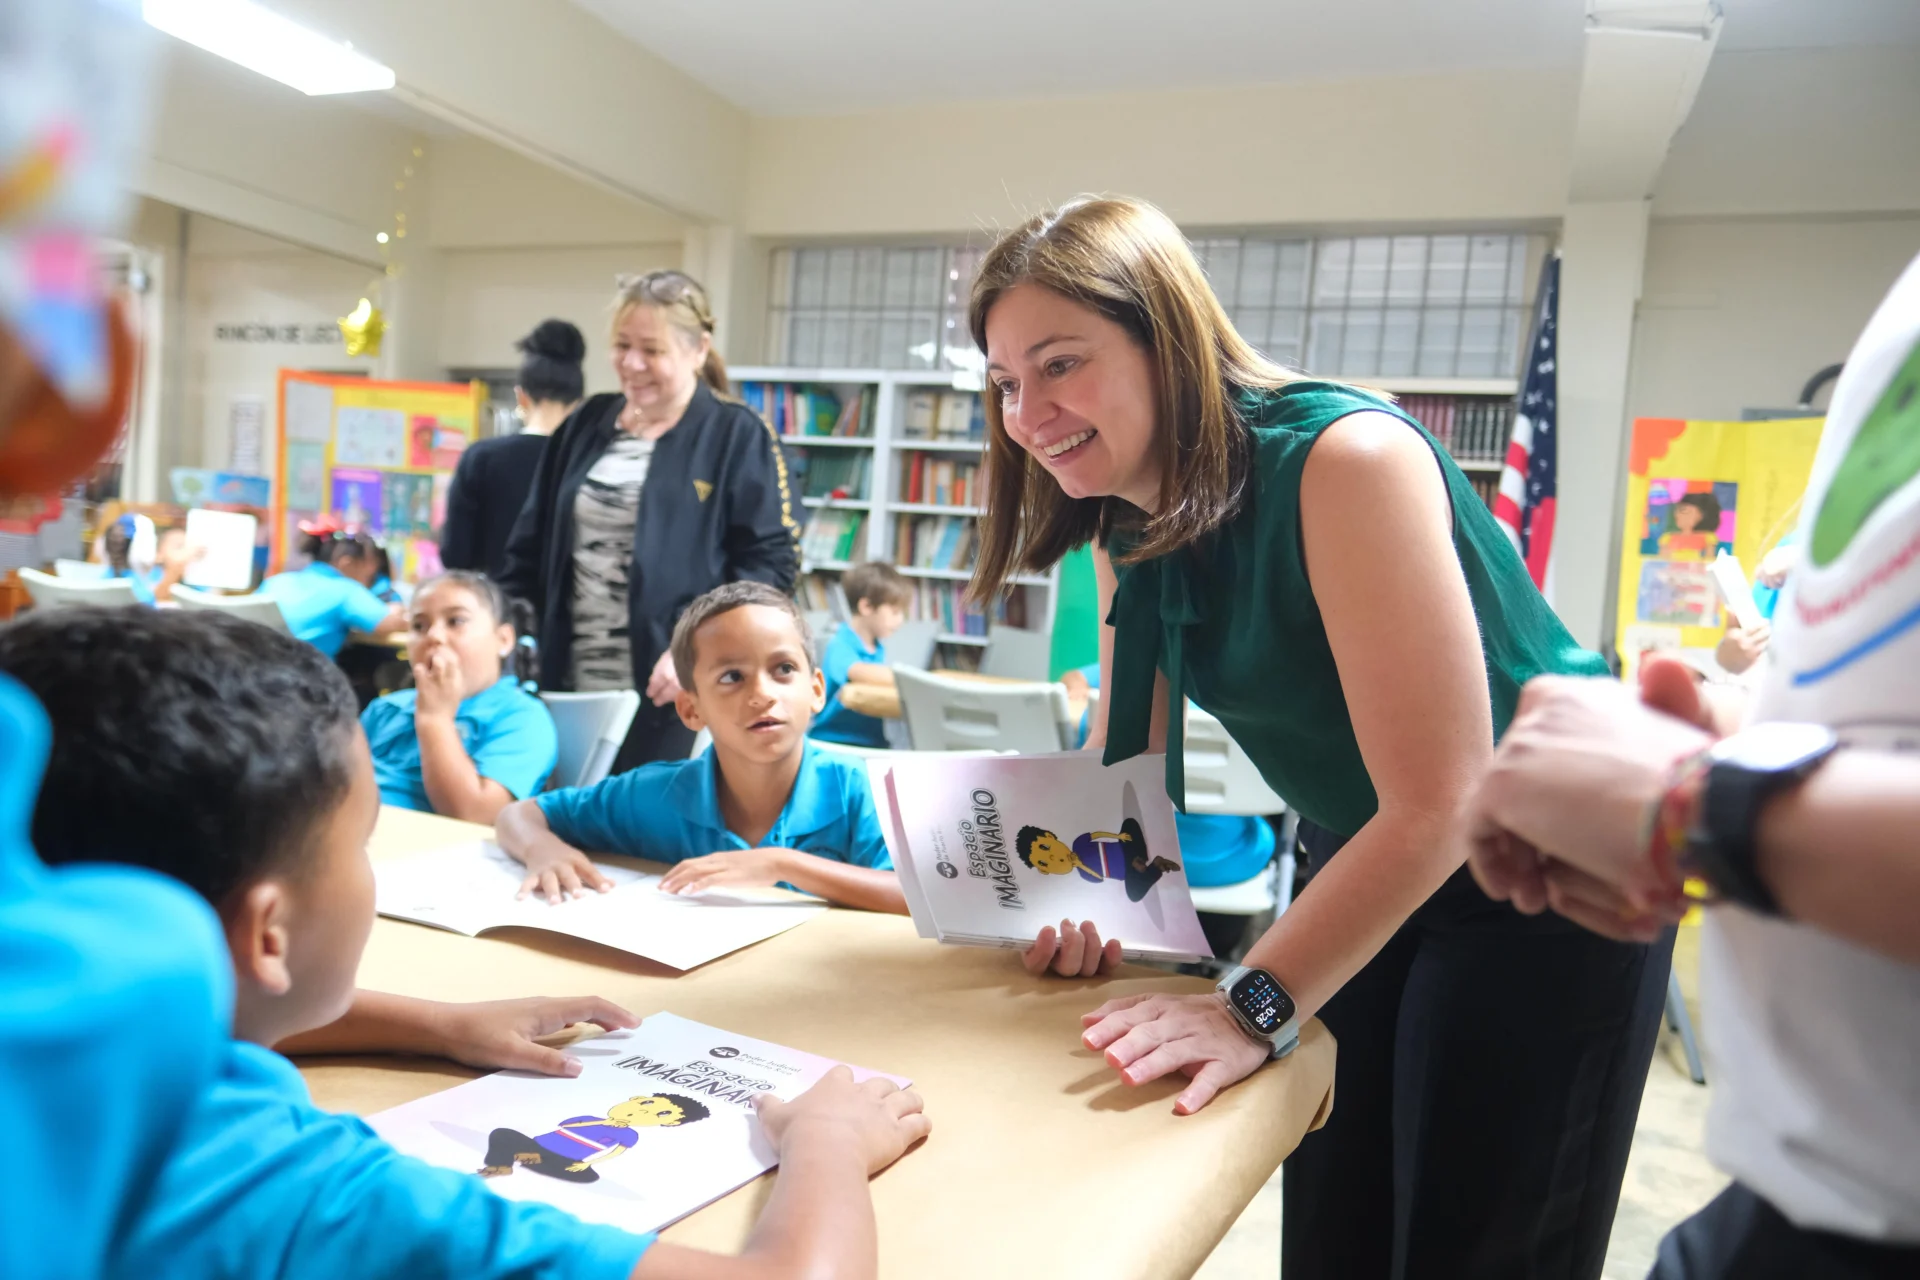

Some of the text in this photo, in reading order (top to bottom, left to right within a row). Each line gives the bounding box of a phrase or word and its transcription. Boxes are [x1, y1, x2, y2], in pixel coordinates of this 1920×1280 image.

[304, 324, 341, 343] LECT
[959, 820, 986, 878] Espacio
[972, 789, 1024, 909] IMAGINARIO
[1255, 1006, 1276, 1025] 10:26
[685, 1060, 773, 1091] Espacio
